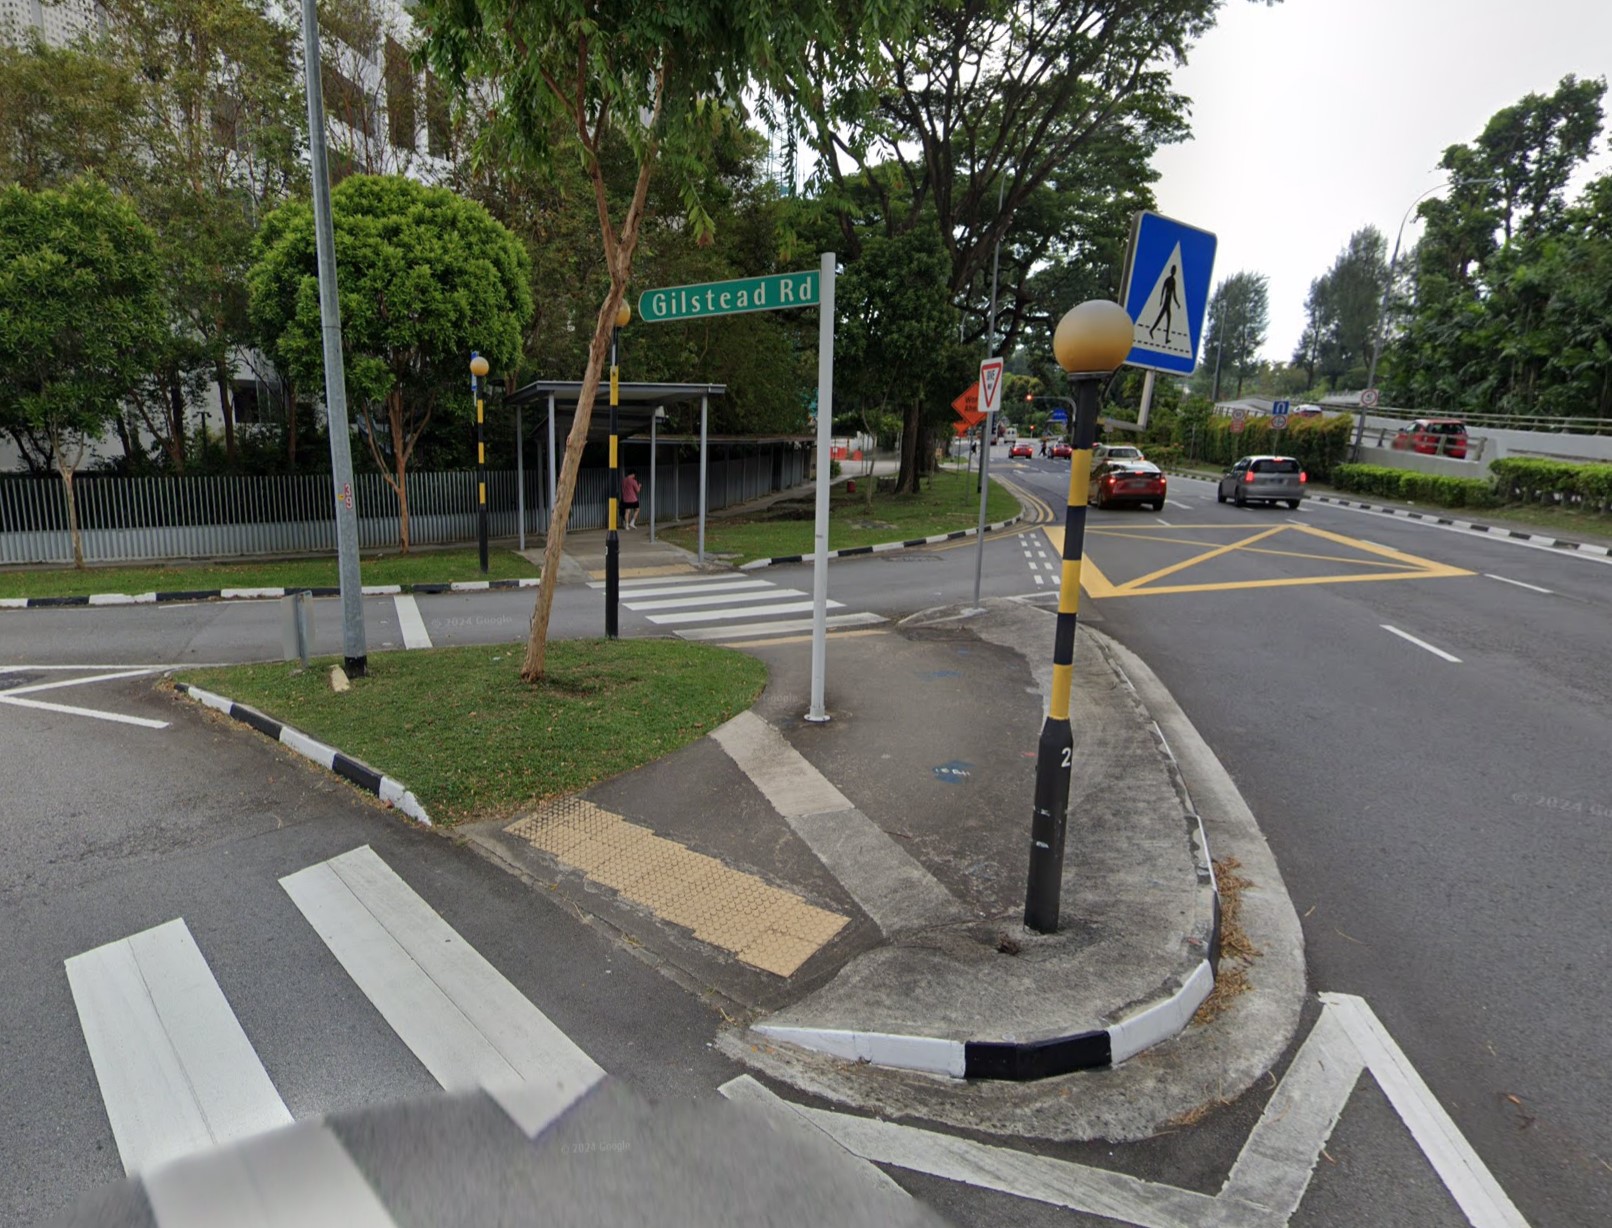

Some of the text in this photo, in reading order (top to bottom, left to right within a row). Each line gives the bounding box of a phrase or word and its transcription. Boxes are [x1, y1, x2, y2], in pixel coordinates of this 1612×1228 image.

[652, 276, 812, 316] Gilstead Rd
[1061, 747, 1072, 768] 2
